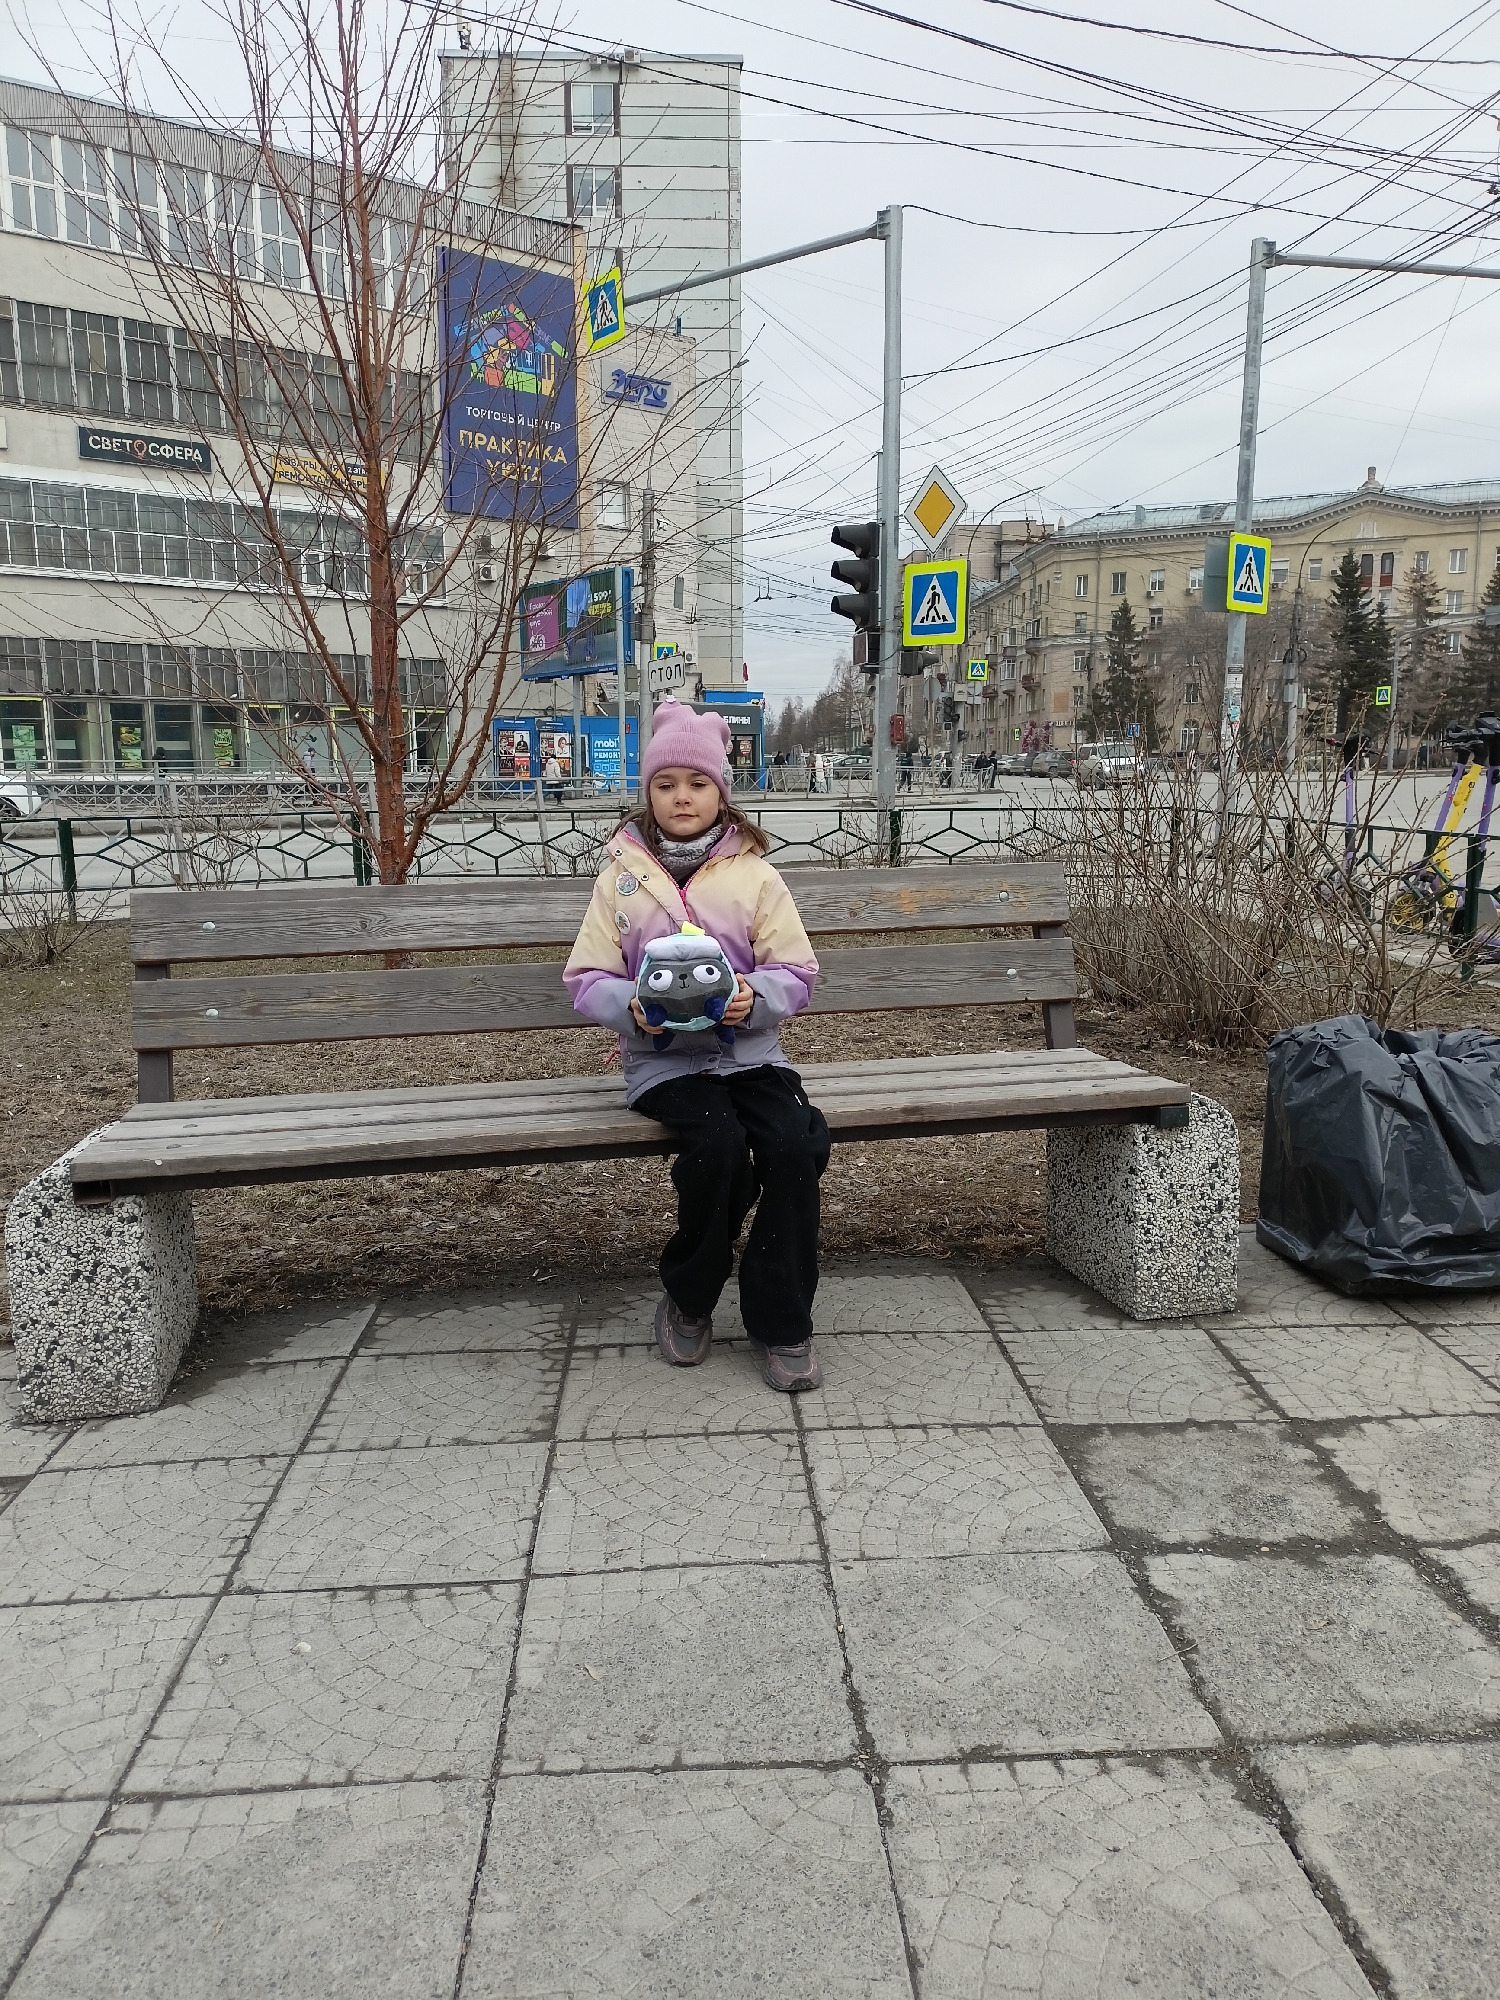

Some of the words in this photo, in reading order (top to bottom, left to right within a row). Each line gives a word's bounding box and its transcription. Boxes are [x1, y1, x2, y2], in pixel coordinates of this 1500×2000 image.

[466, 406, 524, 426] ТОРГОВЫЙ
[460, 429, 568, 464] ПРАКТИКА
[486, 459, 542, 482] УЮТА
[650, 663, 682, 682] СТОП
